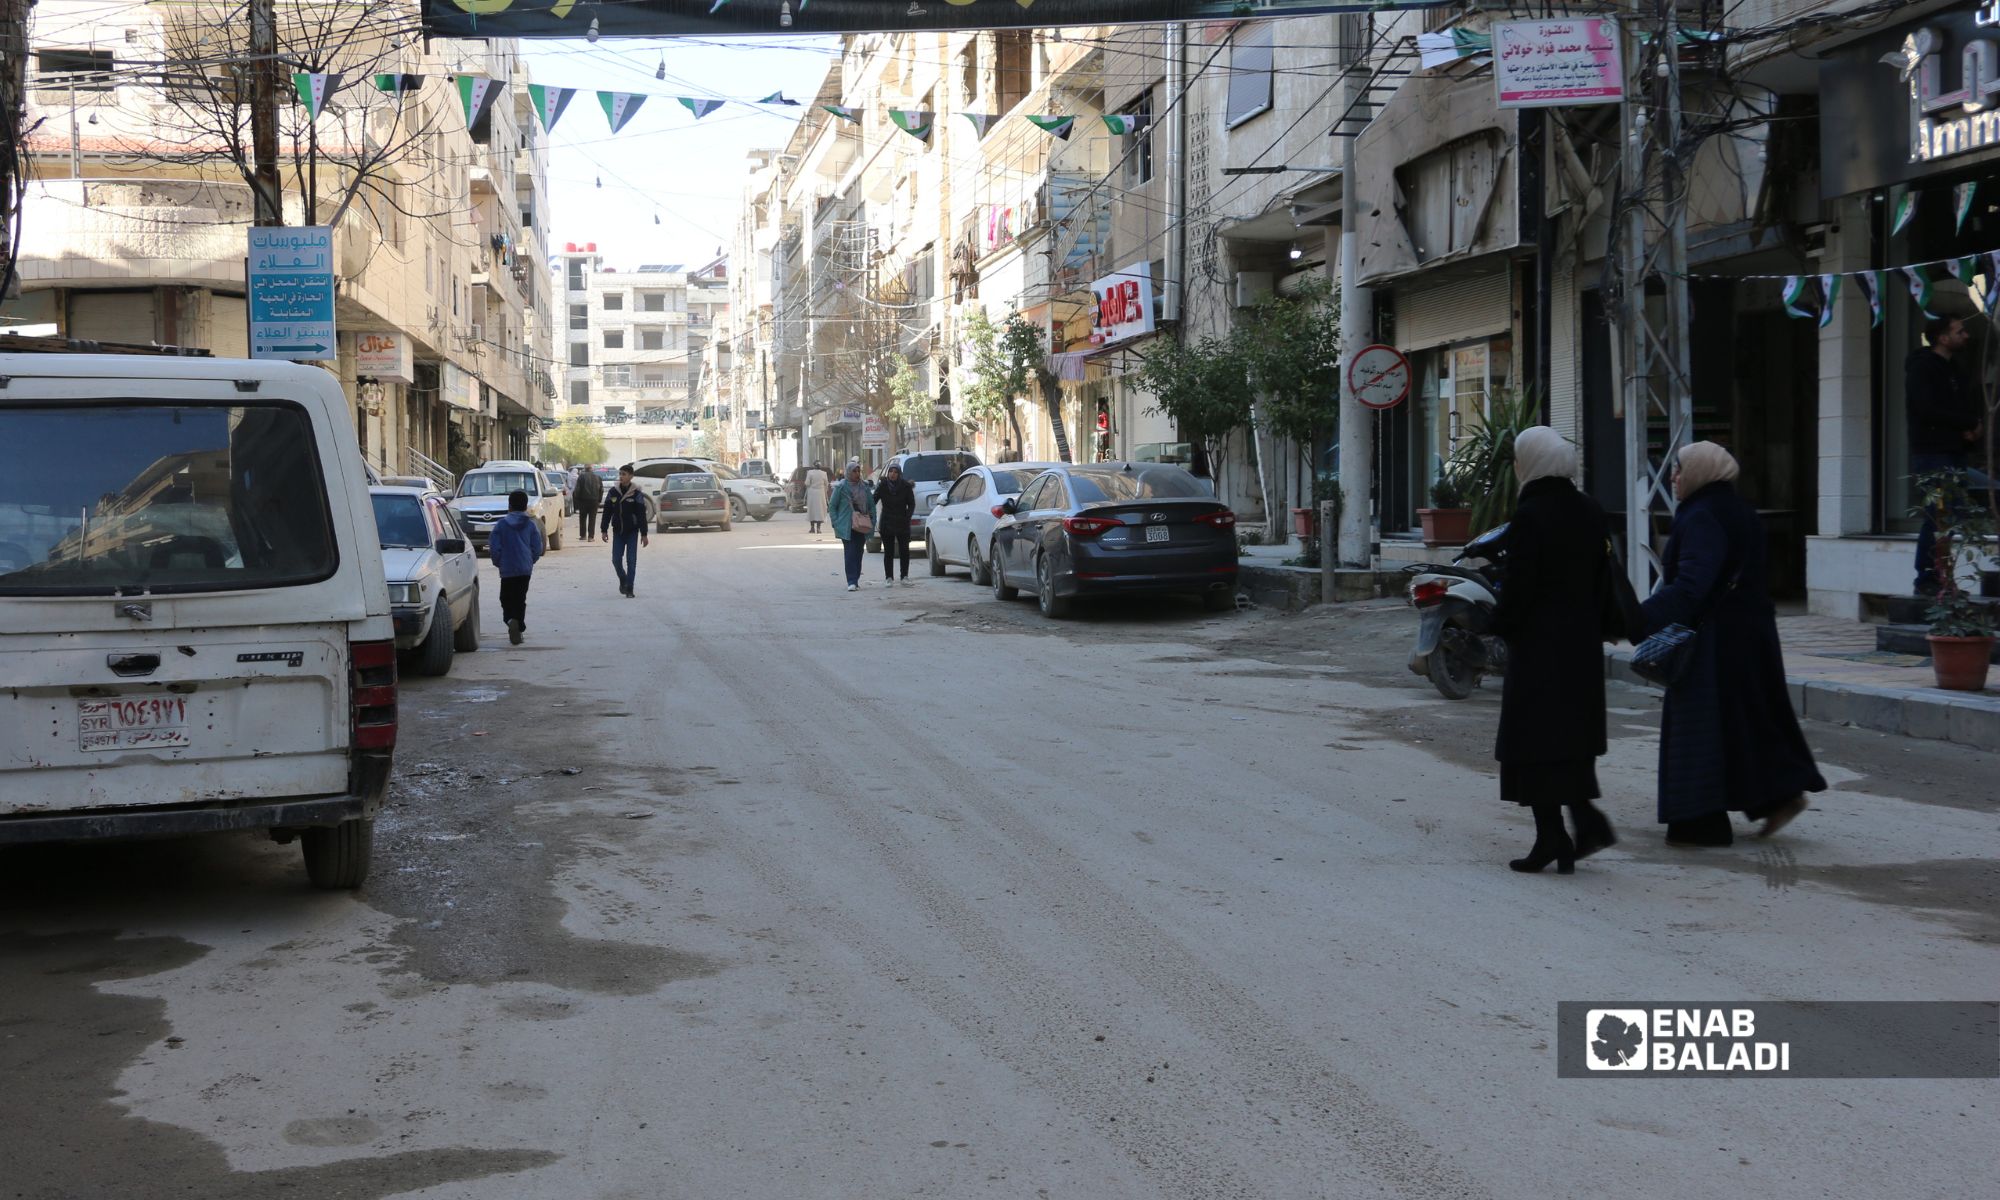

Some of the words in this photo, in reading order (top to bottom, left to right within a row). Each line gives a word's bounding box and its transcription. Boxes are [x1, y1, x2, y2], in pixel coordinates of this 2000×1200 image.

[1539, 25, 1573, 37] الدكتورة
[1557, 42, 1581, 53] محمد
[253, 232, 327, 251] ملبوسات
[269, 276, 299, 289] المحل
[259, 292, 287, 304] الجهة
[288, 291, 296, 304] في
[298, 292, 324, 303] الحارة
[270, 306, 314, 319] المقابلة
[256, 326, 291, 339] العلاء
[359, 335, 395, 353] غزال
[1148, 531, 1168, 541] 3008
[81, 717, 109, 731] SYR
